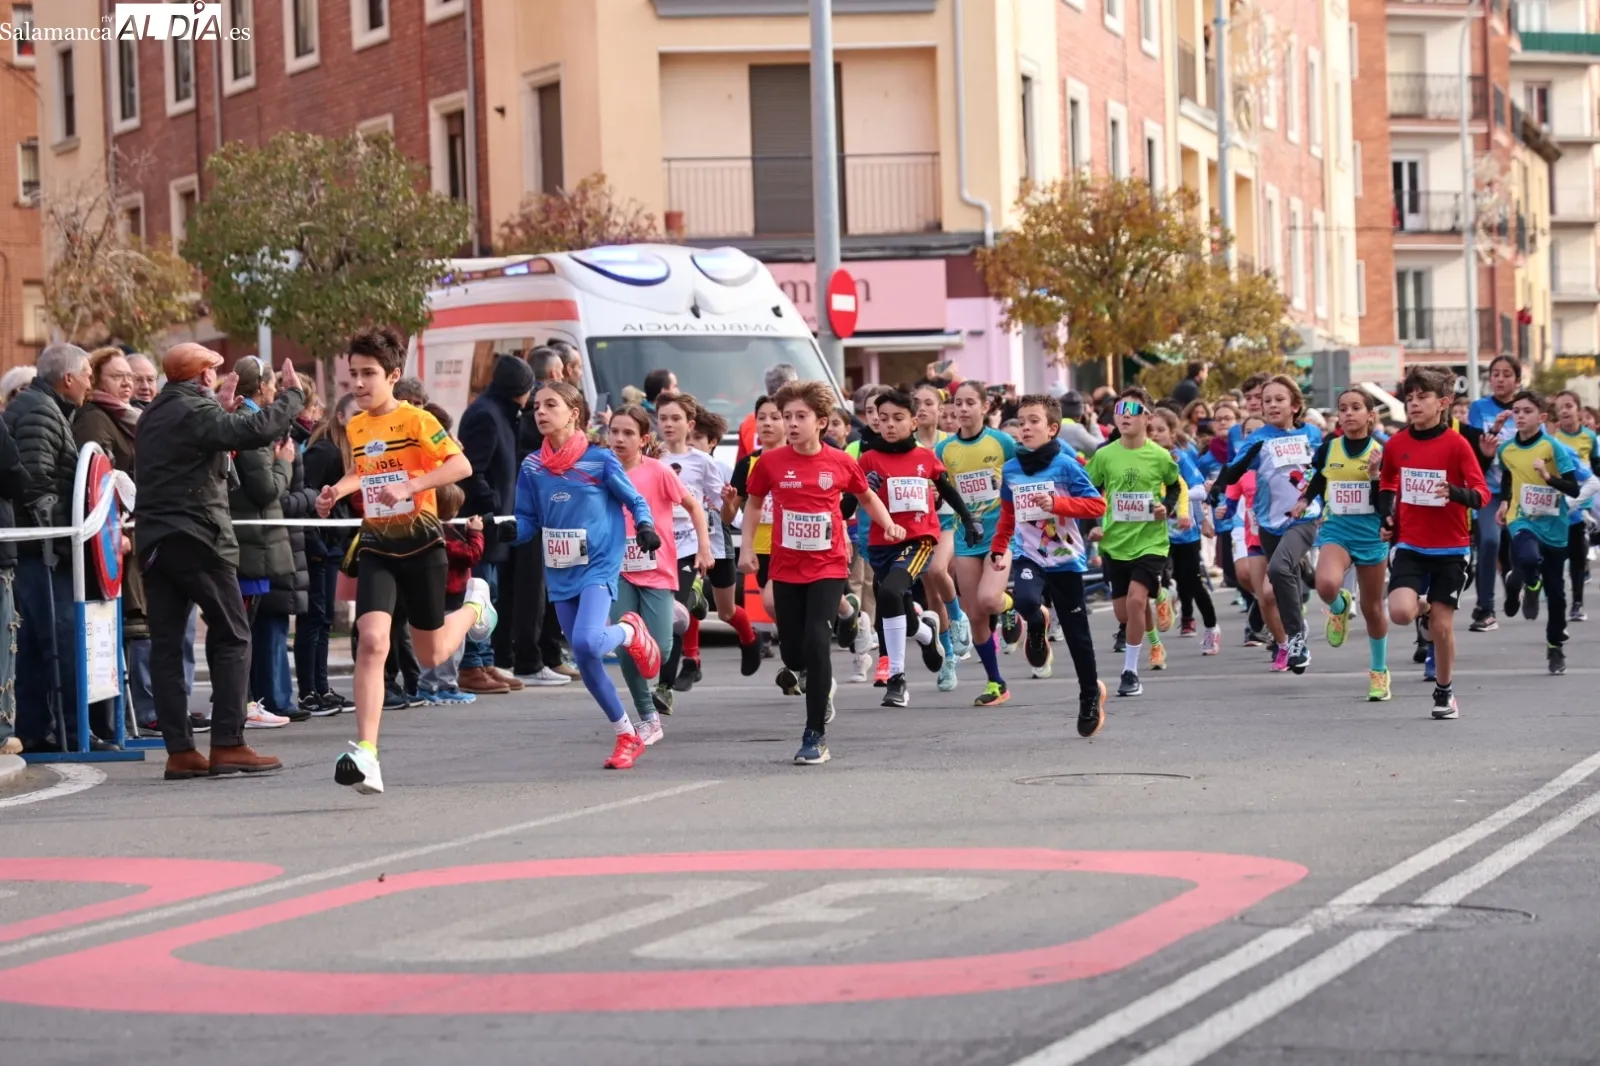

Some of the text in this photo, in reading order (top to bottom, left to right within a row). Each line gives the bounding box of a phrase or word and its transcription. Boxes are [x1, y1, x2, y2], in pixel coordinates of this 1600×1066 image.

[1275, 443, 1303, 457] 6498
[368, 474, 404, 486] SETEL
[963, 471, 991, 480] SETEL
[1410, 470, 1441, 479] SETEL
[960, 478, 987, 494] 6509
[1020, 484, 1050, 493] SETEL
[1405, 478, 1434, 494] 6442
[894, 486, 924, 501] 6448
[1335, 490, 1362, 504] 6510
[1525, 492, 1553, 506] 6349
[1117, 499, 1145, 512] 6443
[795, 514, 827, 522] SETEL
[787, 521, 821, 538] 6538
[547, 539, 570, 556] 6411
